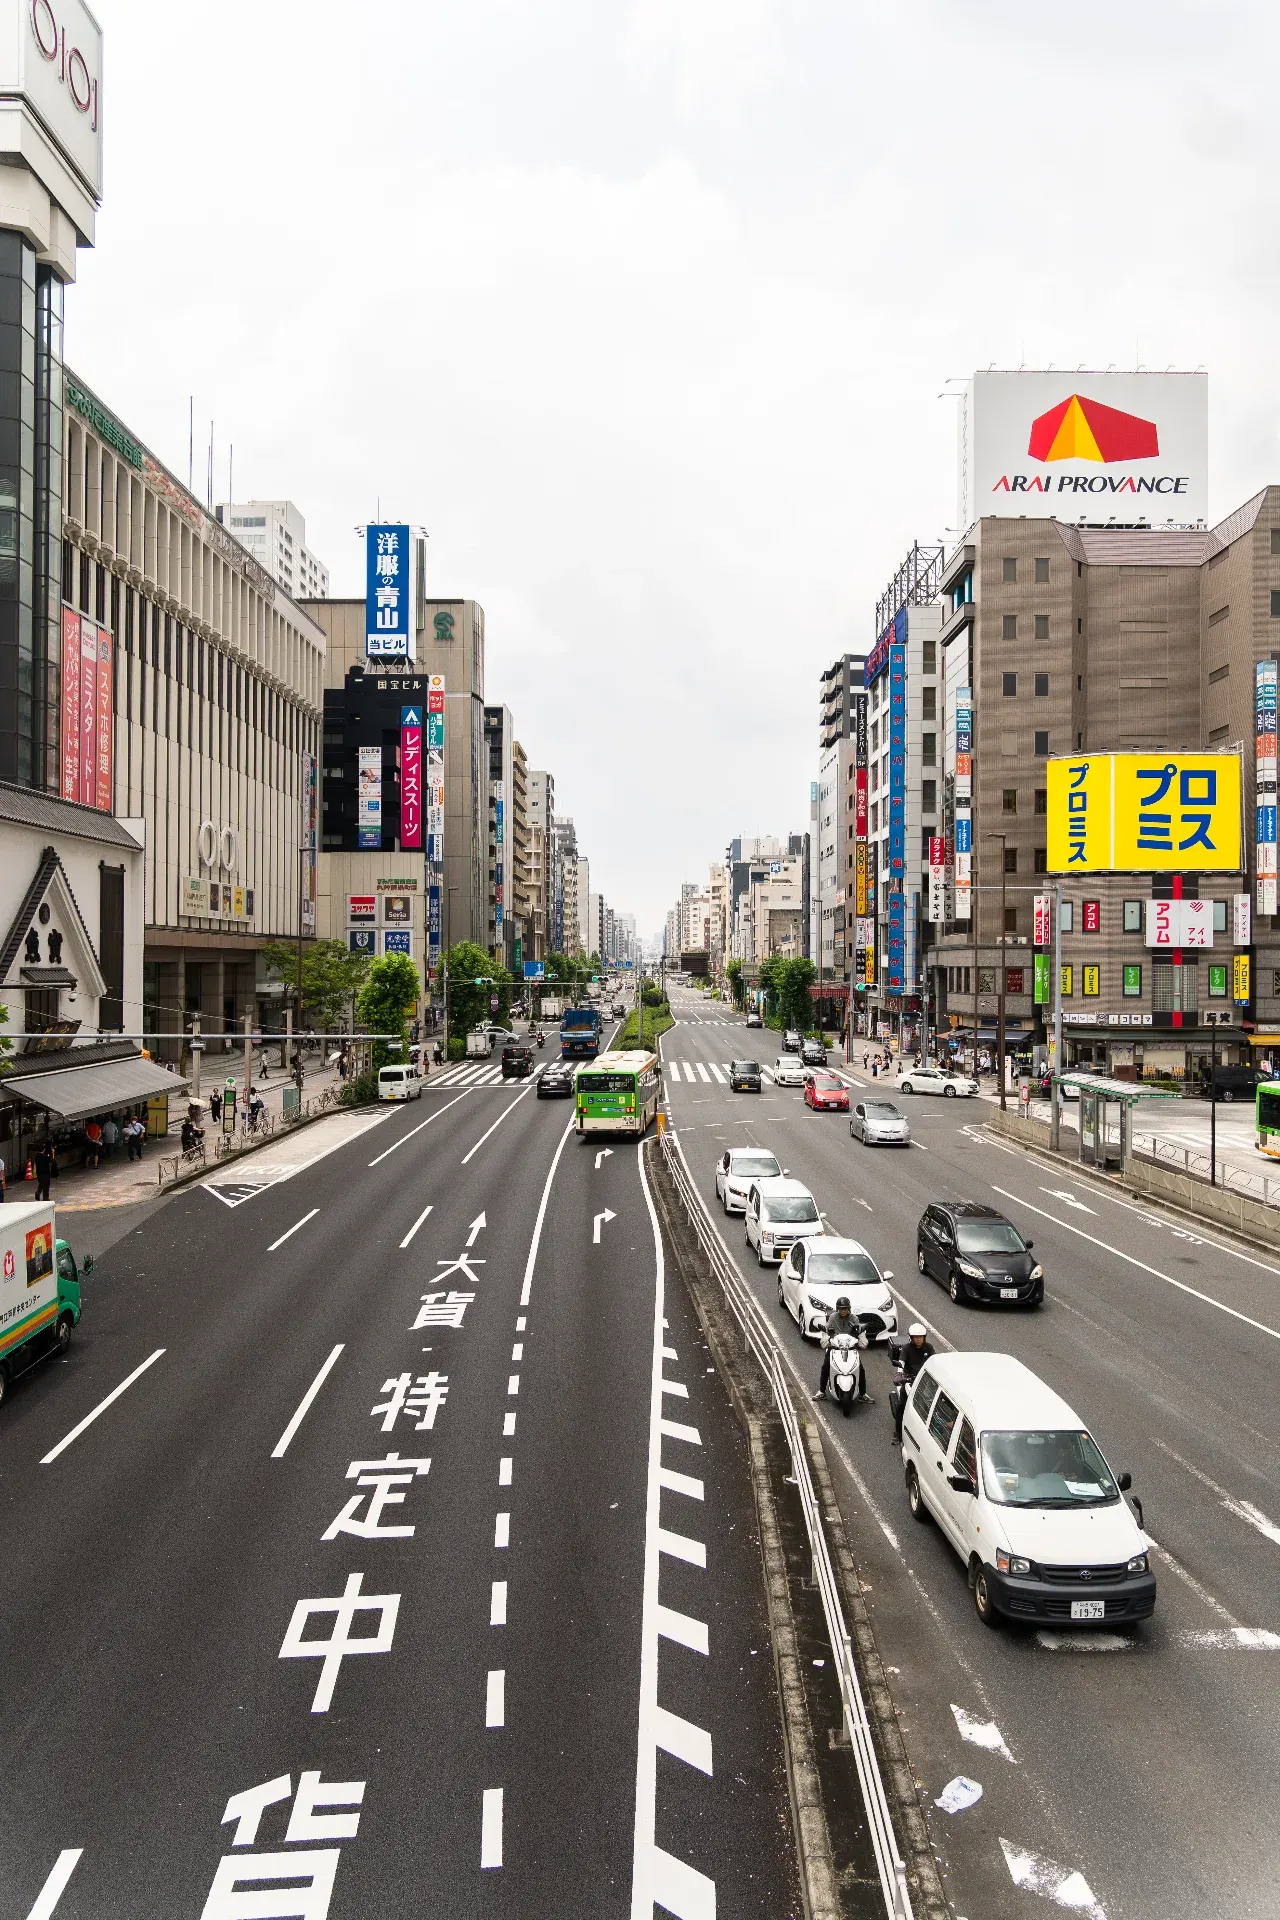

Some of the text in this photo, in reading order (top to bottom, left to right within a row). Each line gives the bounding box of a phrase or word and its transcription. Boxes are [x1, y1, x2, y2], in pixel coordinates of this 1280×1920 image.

[993, 476, 1189, 493] ARAI PROVANCE
[375, 532, 400, 629] 洋服の青山
[370, 638, 405, 650] 当ビル
[434, 632, 454, 640] JRA
[377, 680, 422, 690] 国宝ビル
[100, 671, 109, 775] スマホ修理
[404, 731, 420, 837] レディススーツ
[1136, 763, 1217, 807] プロ
[1068, 763, 1090, 864] プロミス
[1136, 813, 1217, 851] ミス
[933, 838, 941, 865] カラオケ
[1087, 903, 1096, 929] アコム
[1157, 902, 1170, 944] アコム
[1079, 1607, 1103, 1618] 19-75
